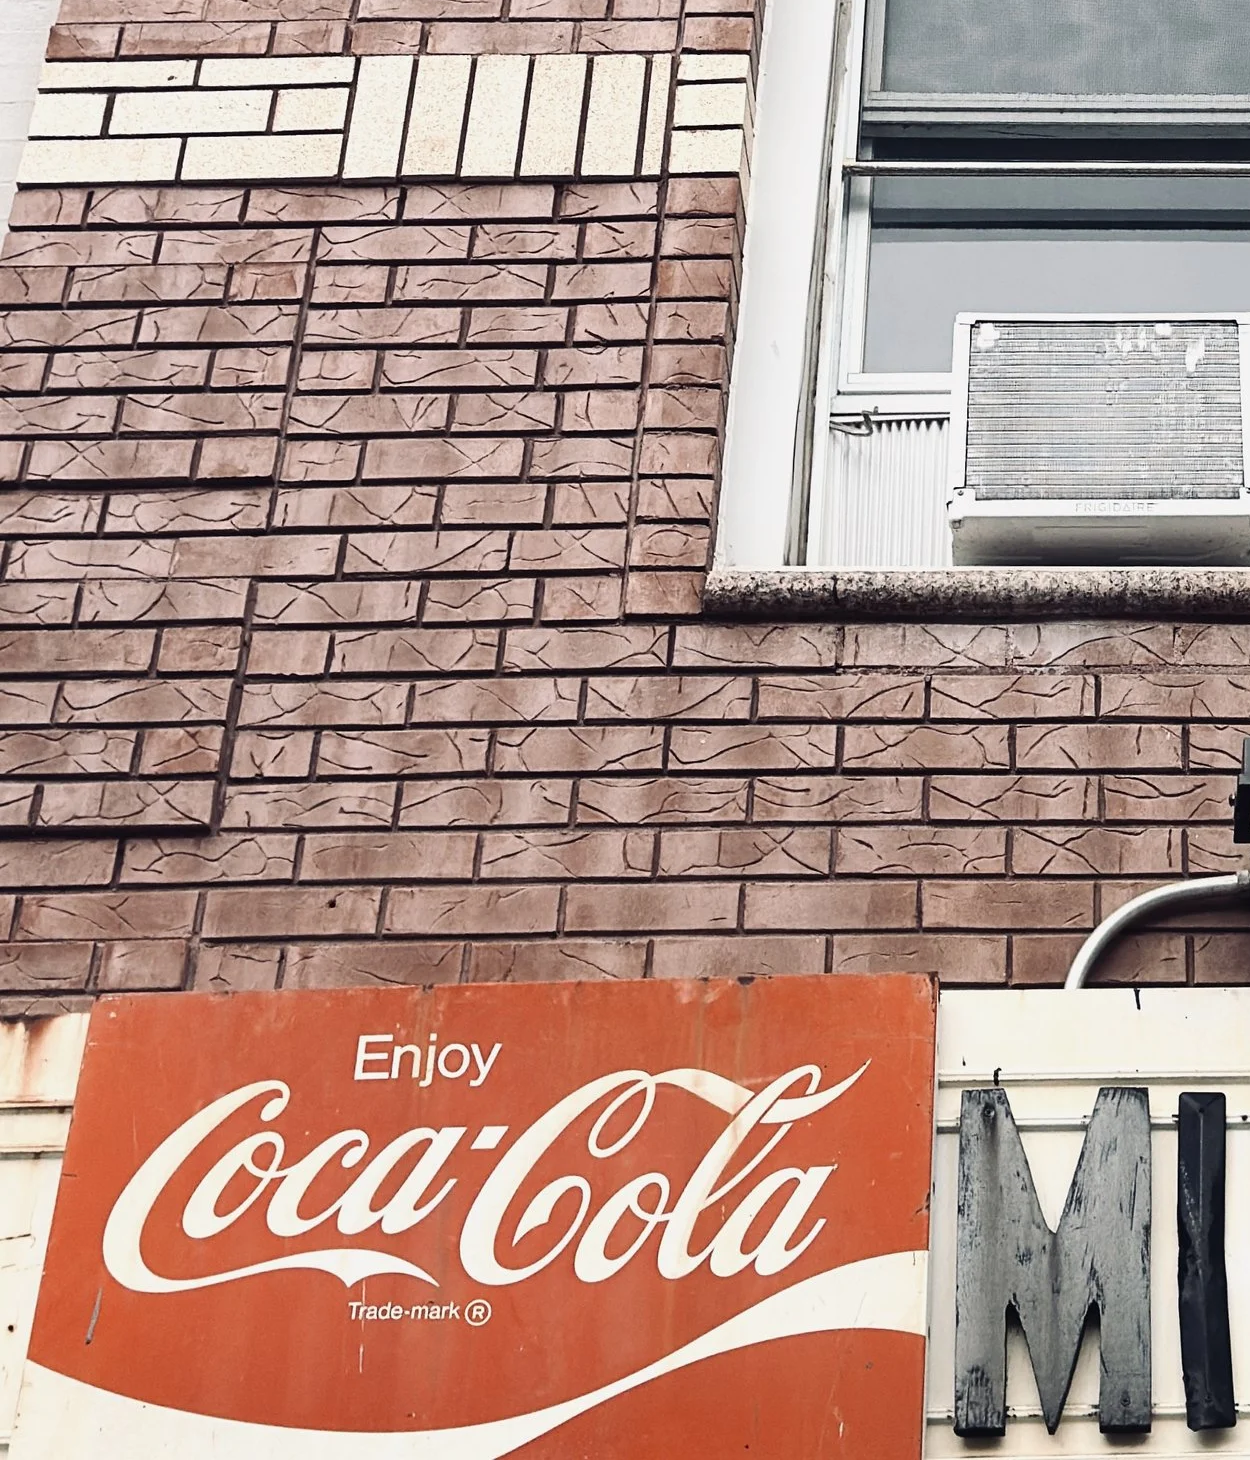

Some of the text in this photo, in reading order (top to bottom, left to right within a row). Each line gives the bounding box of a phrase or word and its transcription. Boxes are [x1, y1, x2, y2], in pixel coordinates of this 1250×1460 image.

[1075, 502, 1157, 513] FRIGIDAIRE
[354, 1033, 502, 1088] Enjoy
[103, 1058, 872, 1293] Coca-Cola
[348, 1301, 460, 1320] Trade-mark
